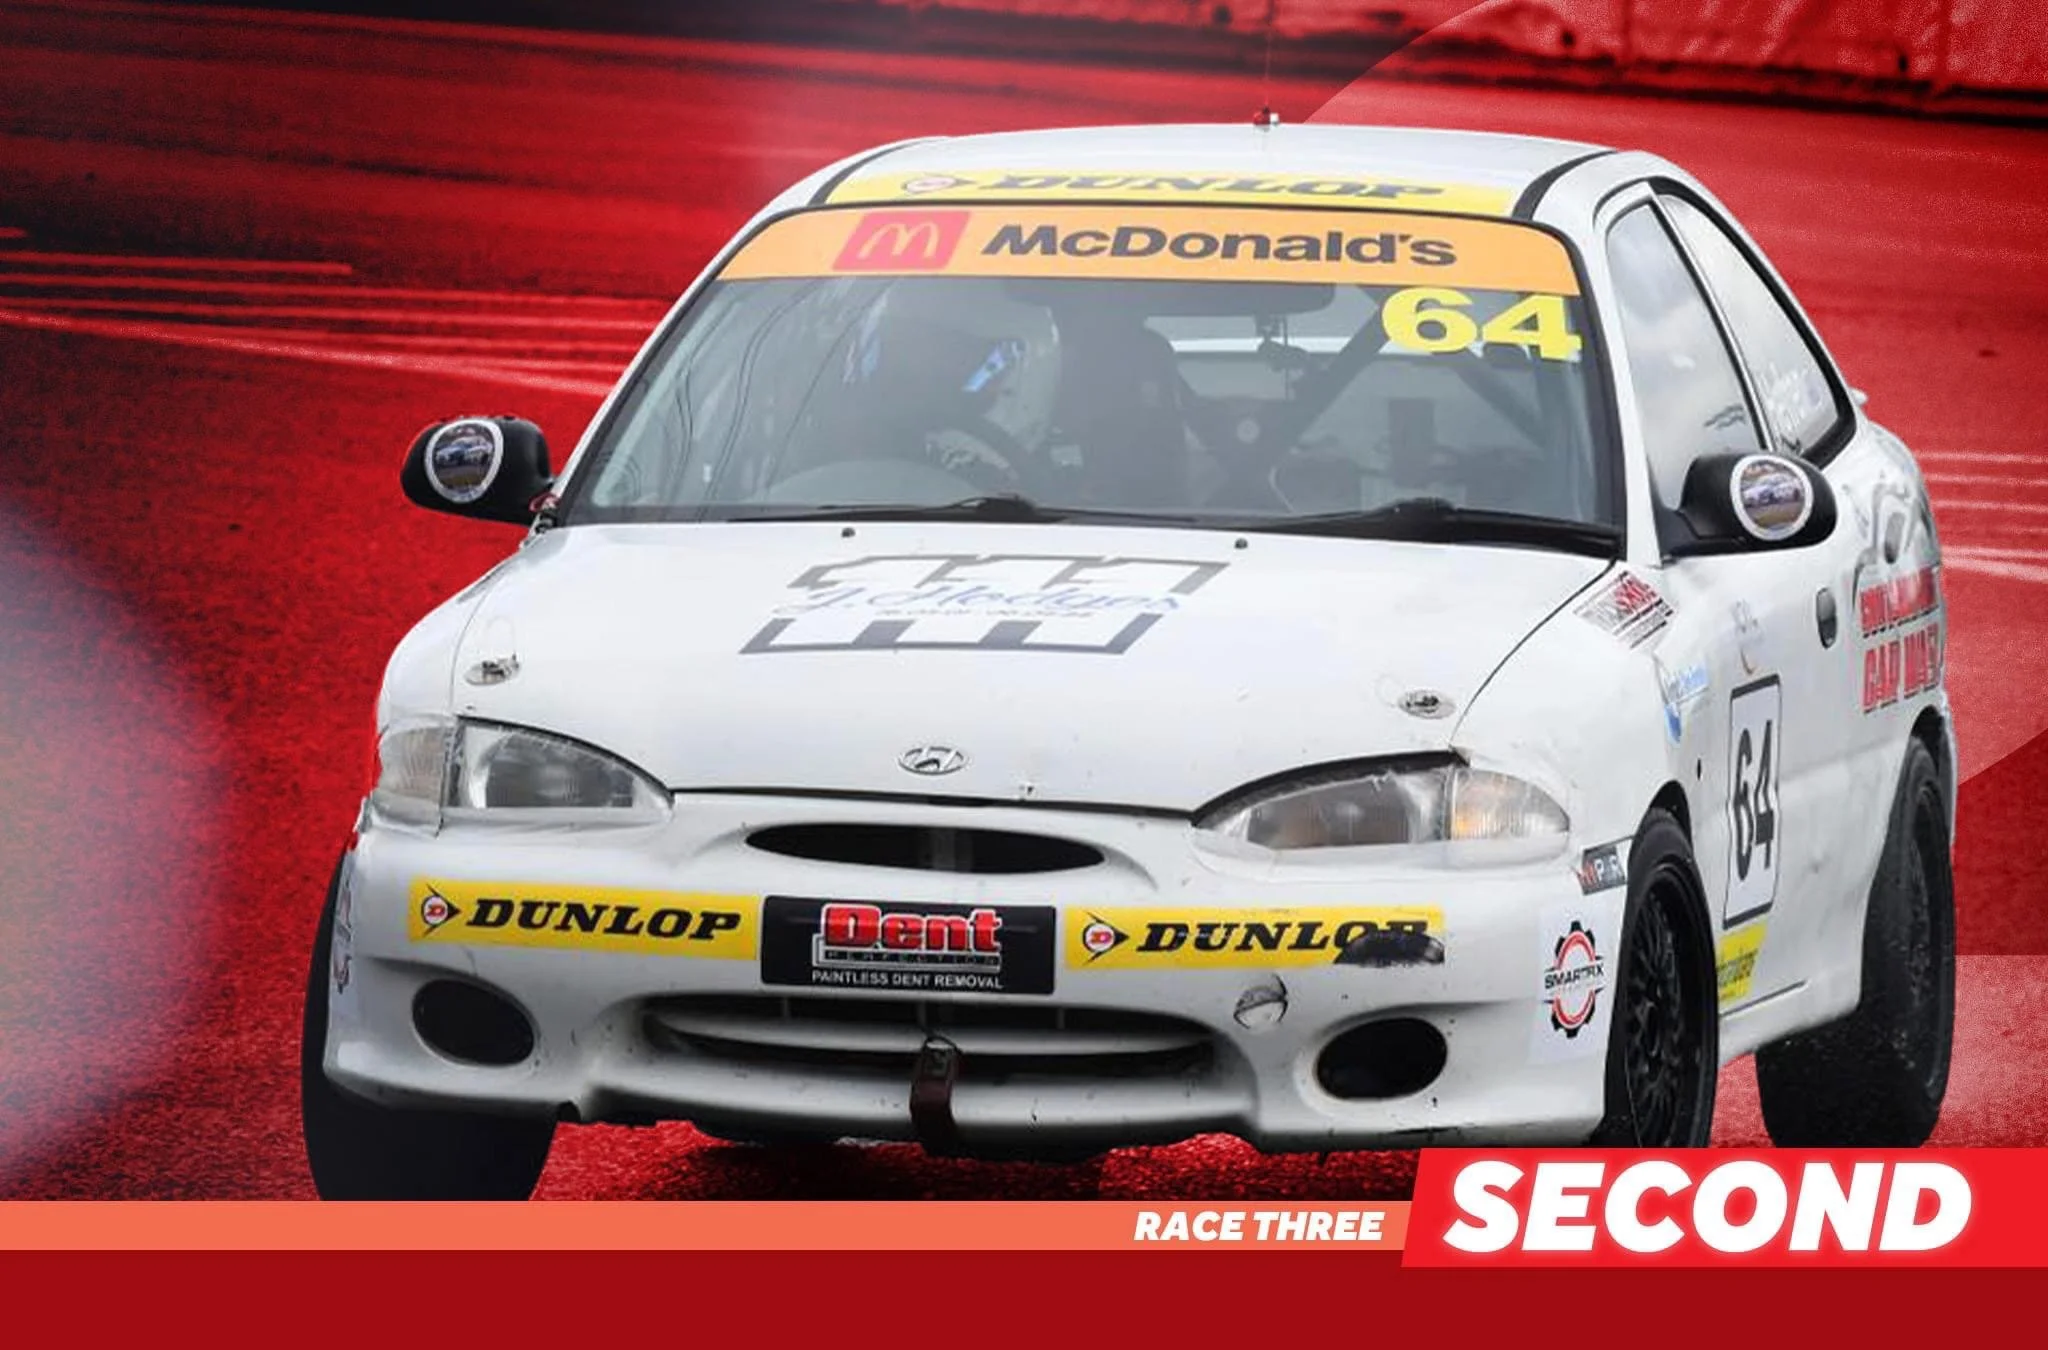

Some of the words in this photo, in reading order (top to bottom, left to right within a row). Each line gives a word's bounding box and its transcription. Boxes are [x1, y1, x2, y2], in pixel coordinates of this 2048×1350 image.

[979, 174, 1443, 199] DUNLOP
[981, 224, 1457, 266] McDonald's
[1381, 287, 1583, 362] 64
[1734, 719, 1774, 882] 64
[465, 898, 741, 940] DUNLOP
[821, 903, 1002, 954] Dent
[811, 970, 889, 985] PAINTLESS
[892, 974, 931, 987] DENT
[934, 974, 1003, 989] REMOVAL
